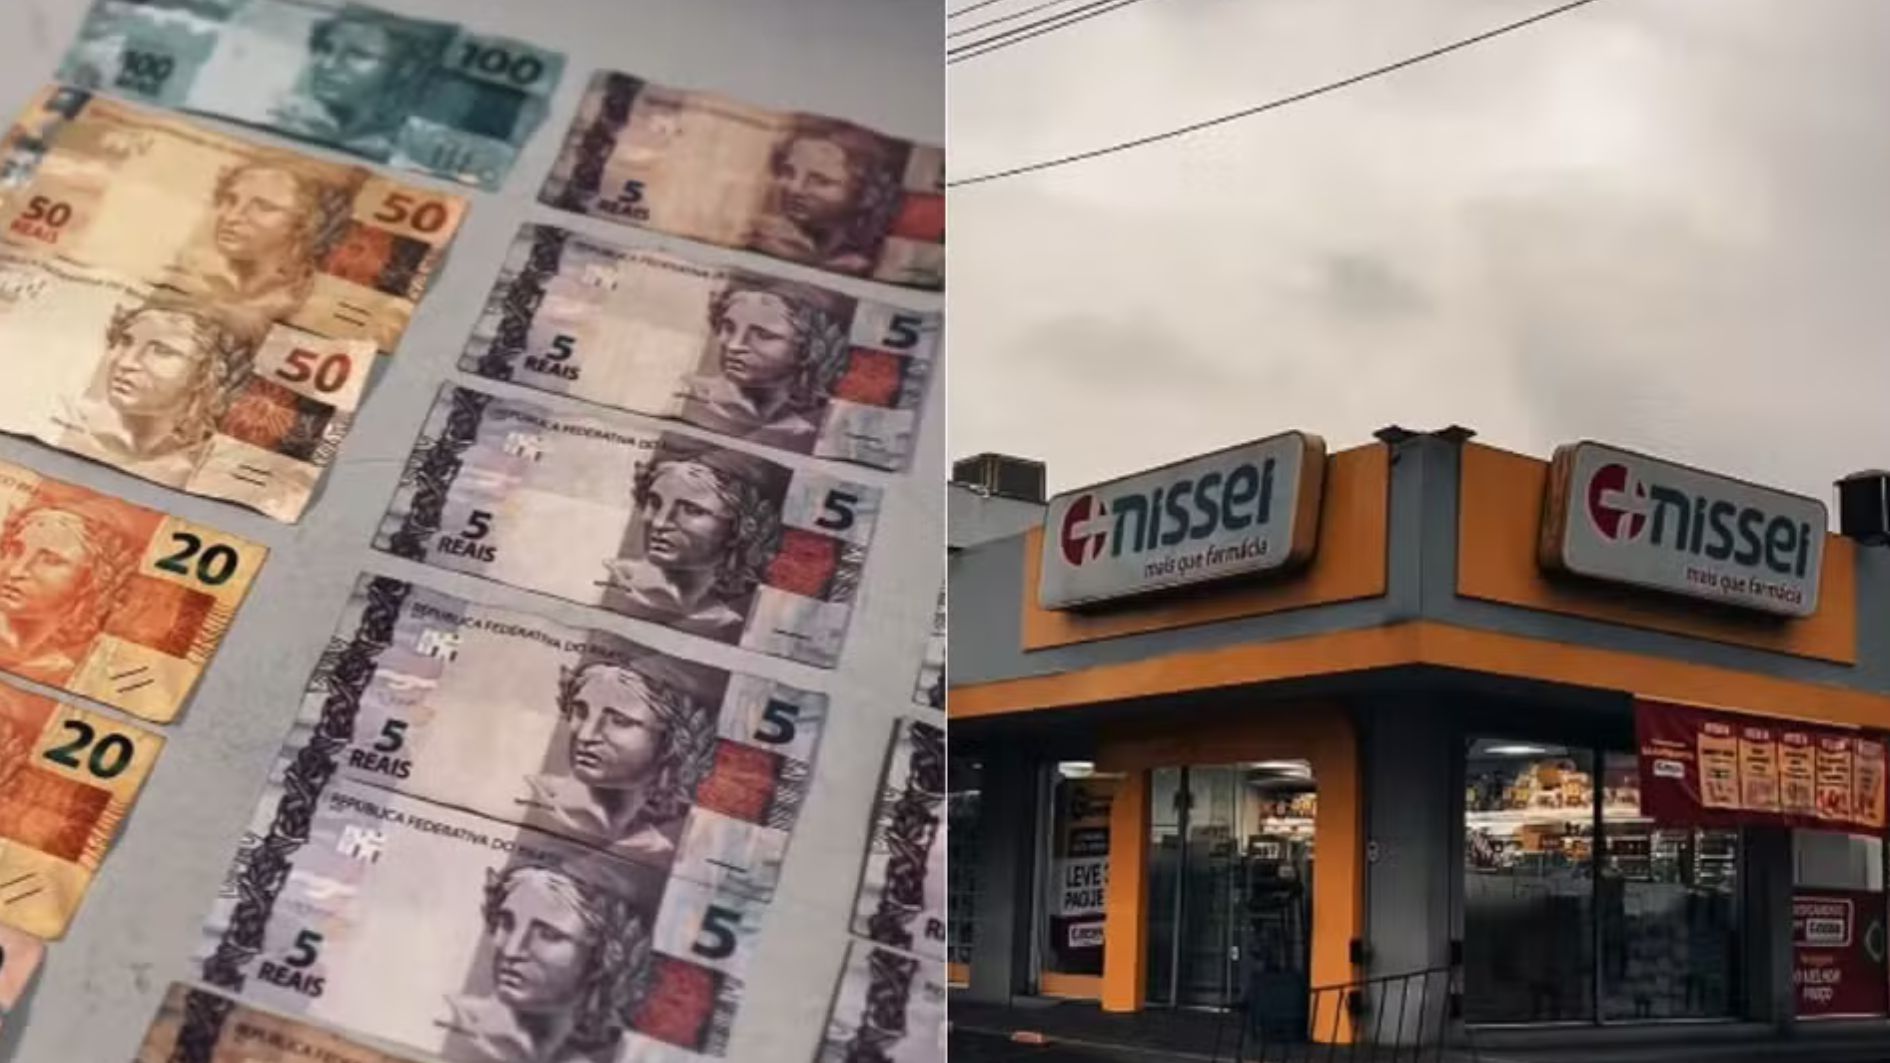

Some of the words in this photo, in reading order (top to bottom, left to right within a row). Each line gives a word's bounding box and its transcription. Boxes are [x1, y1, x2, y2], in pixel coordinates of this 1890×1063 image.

[460, 42, 545, 85] 100
[618, 180, 645, 202] 5
[22, 196, 73, 228] 50
[374, 191, 447, 234] 50
[546, 334, 577, 362] 5
[883, 314, 921, 350] 5
[275, 352, 352, 394] 50
[524, 355, 580, 383] REAIS
[816, 489, 862, 528] 5
[1111, 458, 1275, 556] nissei
[461, 510, 493, 541] 5
[1650, 485, 1810, 578] nissei
[154, 532, 239, 586] 20
[437, 534, 498, 563] REAIS
[1143, 556, 1175, 578] mais
[1177, 551, 1203, 577] que
[1686, 565, 1718, 587] mais
[1719, 572, 1746, 594] que
[373, 718, 408, 753] 5
[753, 699, 799, 745] 5
[42, 720, 135, 779] 20
[349, 749, 413, 780] REAIS
[407, 814, 489, 847] FEDERATIVA
[1065, 864, 1101, 888] LEVE
[284, 929, 323, 967] 5
[691, 904, 743, 960] 5
[257, 961, 326, 998] REAIS
